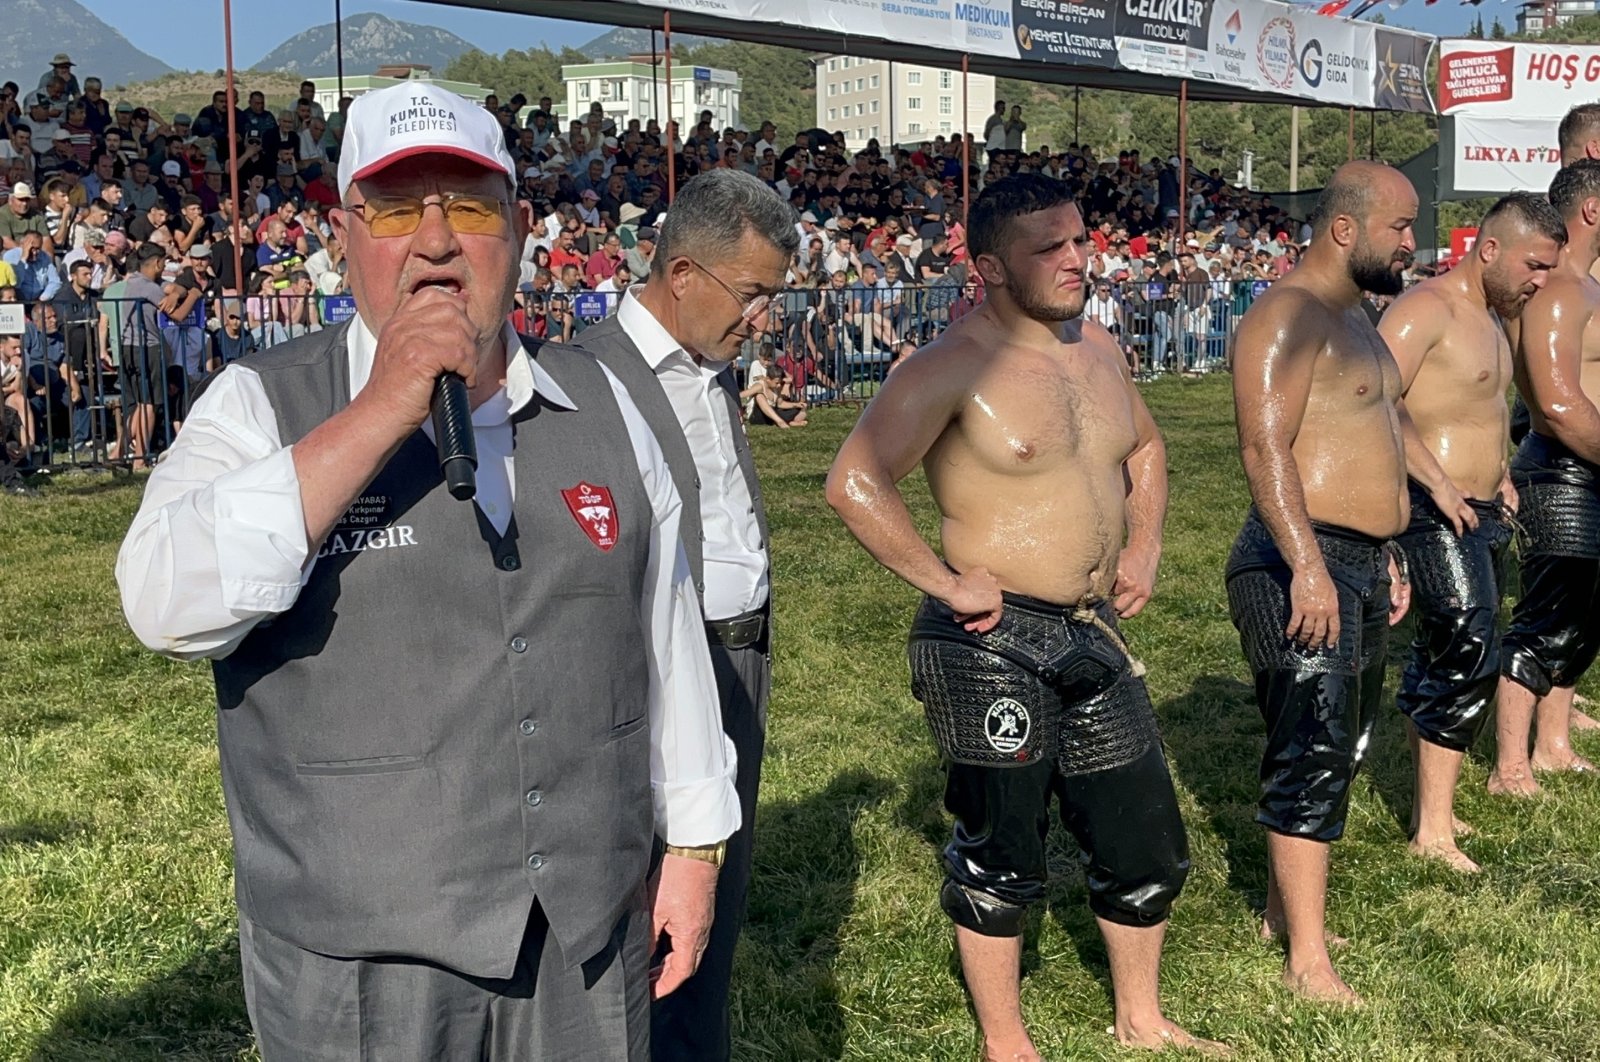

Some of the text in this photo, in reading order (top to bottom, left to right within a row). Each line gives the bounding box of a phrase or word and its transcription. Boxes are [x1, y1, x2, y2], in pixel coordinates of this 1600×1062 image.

[881, 3, 901, 14] SERA
[903, 7, 951, 20] OTOMASYON
[1060, 2, 1105, 20] BİRCAN
[1326, 51, 1370, 72] GELİDONYA
[1448, 55, 1499, 69] GELENEKSEL
[1325, 69, 1348, 84] GIDA
[1449, 64, 1499, 79] KUMLUCA
[1526, 53, 1580, 90] HOŞ
[410, 96, 433, 106] T.C.
[390, 107, 457, 125] KUMLUCA
[389, 117, 458, 137] BELEDİYESİ
